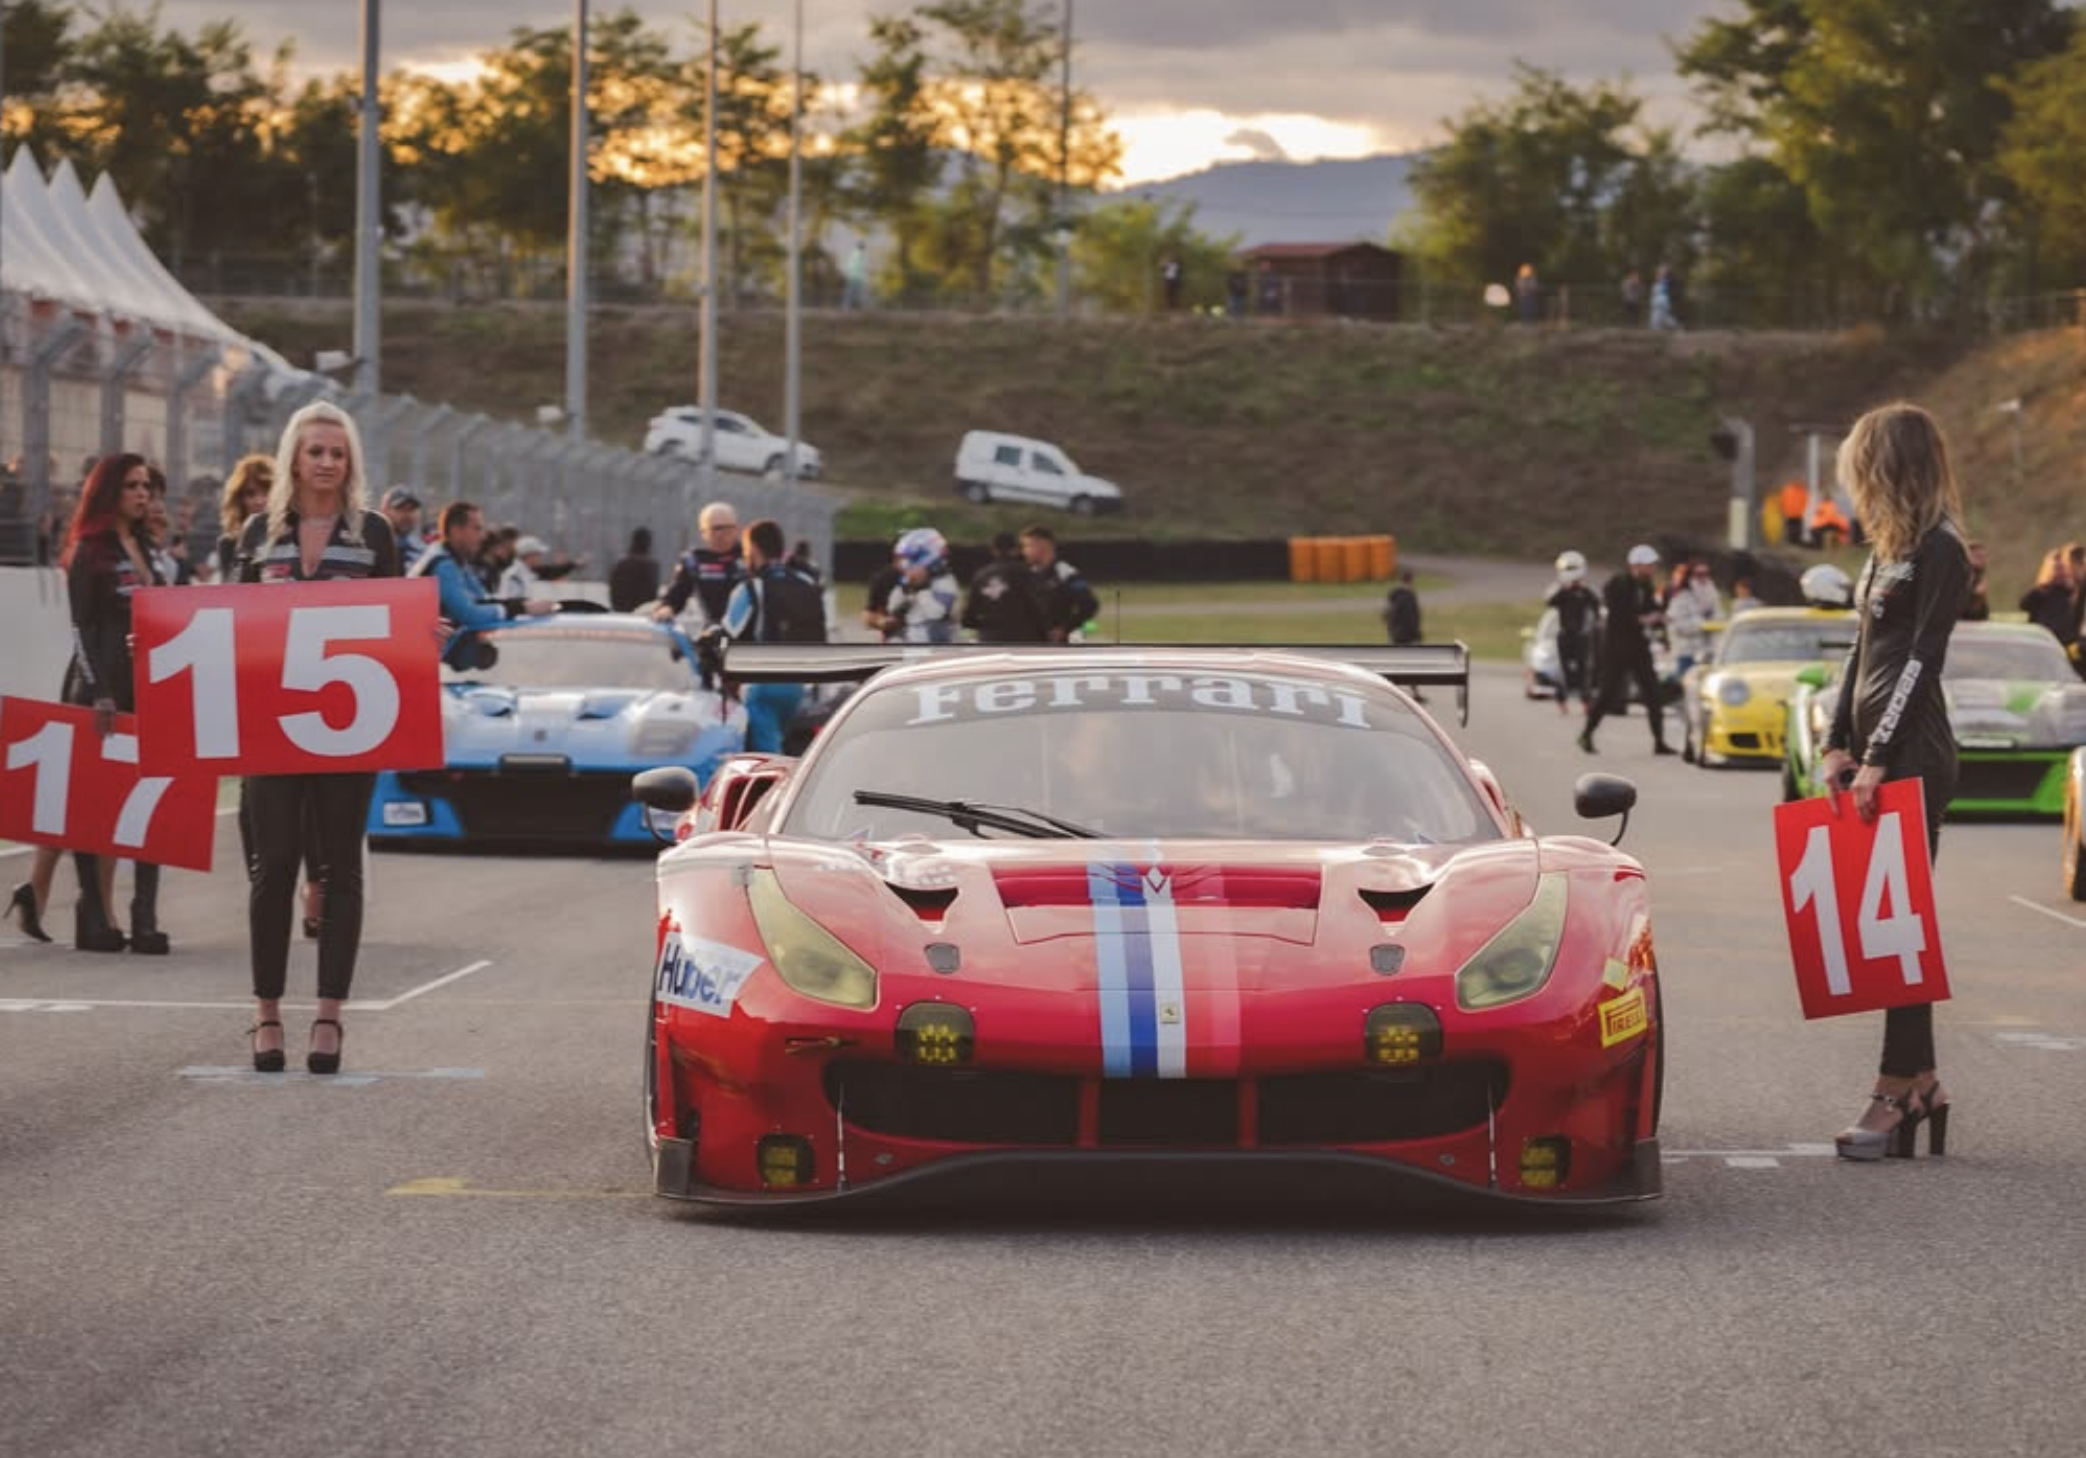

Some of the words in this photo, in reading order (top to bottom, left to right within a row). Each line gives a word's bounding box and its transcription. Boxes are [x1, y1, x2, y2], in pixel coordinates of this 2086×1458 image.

[148, 604, 401, 760] 15
[905, 675, 1372, 729] Ferrari
[6, 720, 175, 849] 17
[1790, 811, 1927, 996] 14
[657, 941, 742, 1005] Huber
